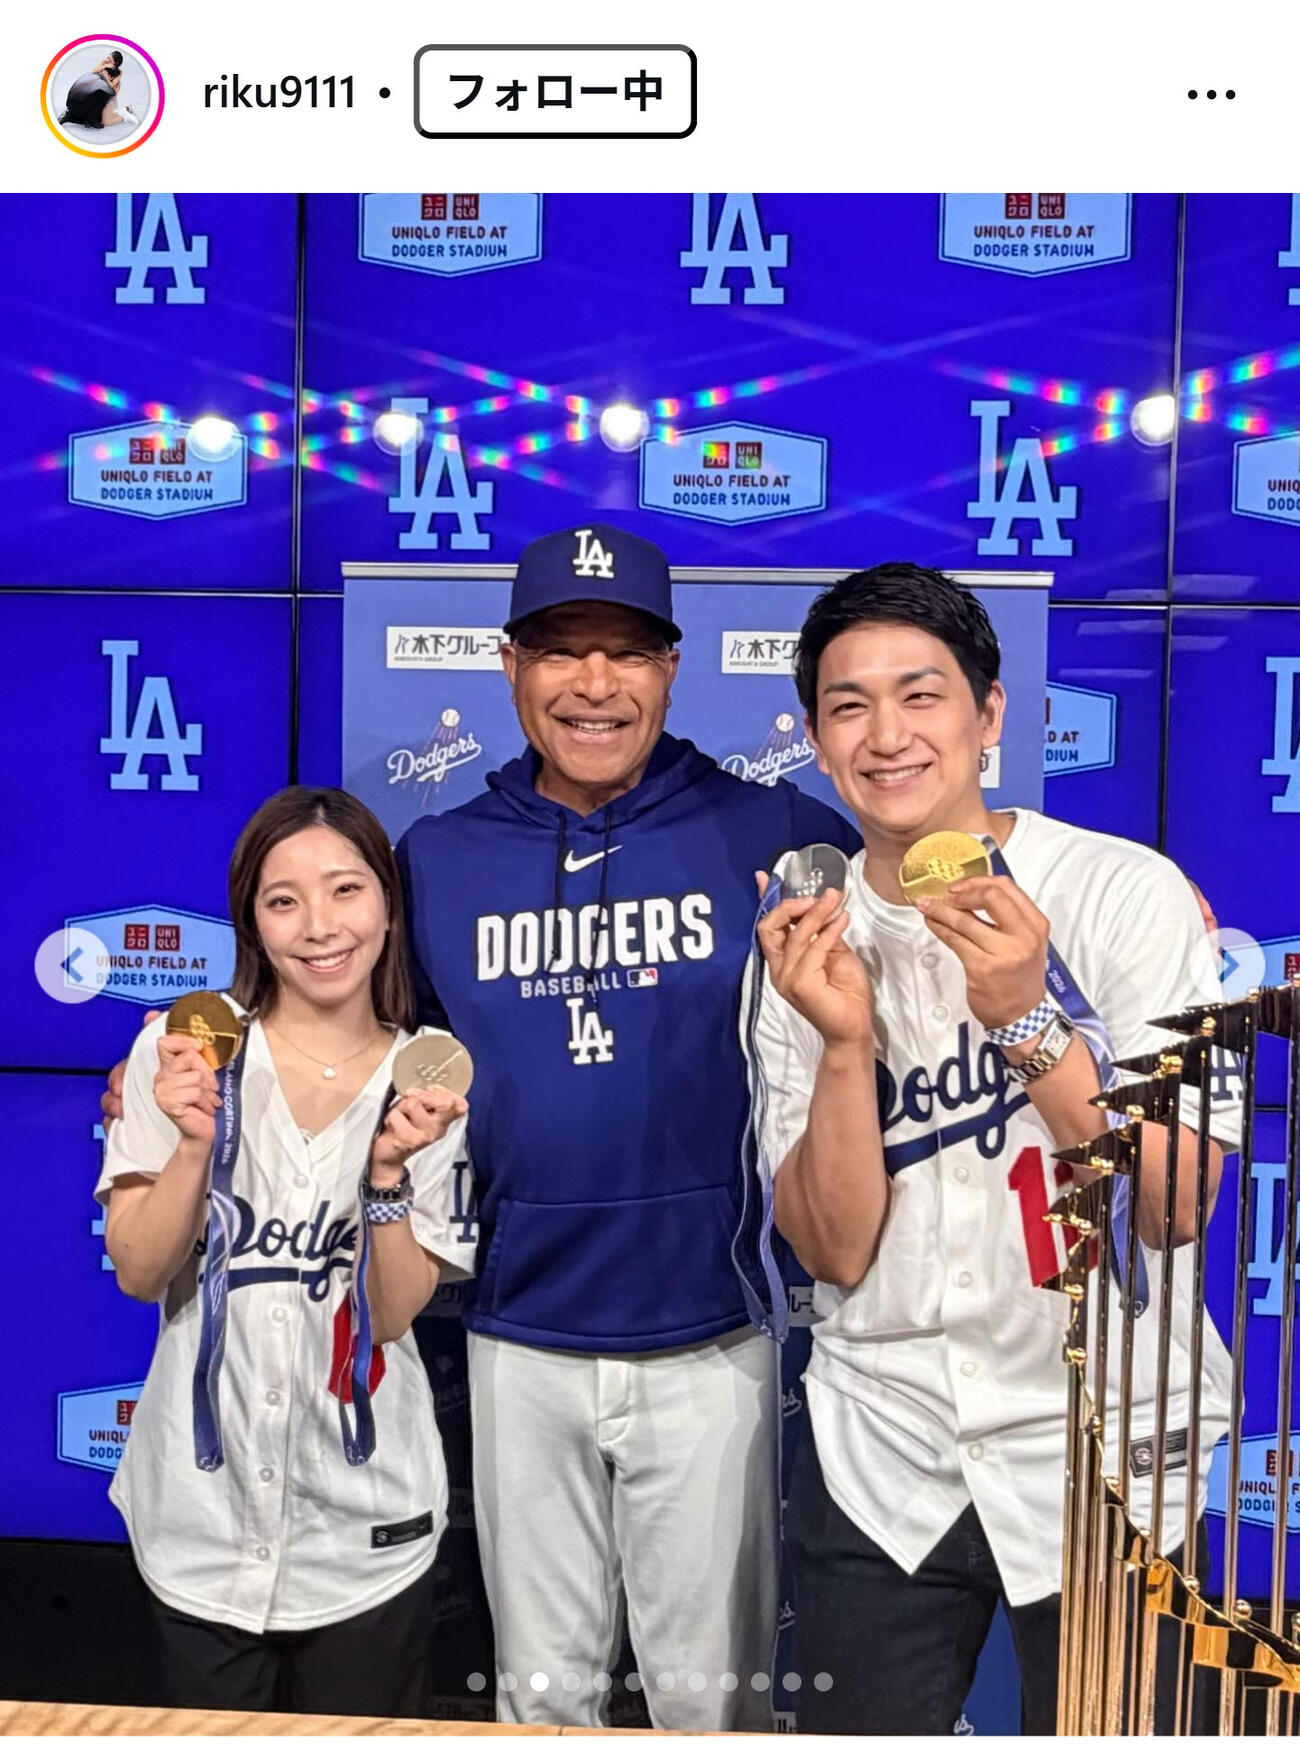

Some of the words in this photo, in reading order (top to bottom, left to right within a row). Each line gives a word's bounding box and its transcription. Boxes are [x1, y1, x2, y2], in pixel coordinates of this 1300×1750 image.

[455, 207, 477, 218] QLO
[1040, 206, 1063, 217] QLO
[391, 226, 441, 241] UNIQLO
[446, 226, 486, 239] FIELD
[490, 226, 508, 239] AT
[973, 225, 1025, 240] UNIQLO
[1030, 225, 1072, 238] FIELD
[1076, 225, 1095, 238] AT
[105, 193, 208, 304] LA
[391, 244, 445, 258] DODGER
[449, 244, 508, 257] STADIUM
[680, 193, 788, 305] LA
[973, 243, 1029, 257] DODGER
[1033, 243, 1095, 257] STADIUM
[100, 470, 149, 485] UNIQLO
[153, 470, 192, 483] FIELD
[196, 470, 213, 483] AT
[388, 397, 493, 550] LA
[966, 400, 1077, 556] LA
[673, 474, 723, 489] UNIQLO
[728, 475, 769, 488] FIELD
[773, 475, 791, 488] AT
[1267, 479, 1300, 494] UNIQ
[100, 487, 152, 501] DODGER
[156, 487, 213, 501] STADIUM
[673, 492, 727, 506] DODGER
[731, 492, 791, 506] STADIUM
[573, 529, 614, 579] LA
[100, 640, 202, 791] LA
[1061, 731, 1079, 744] AT
[387, 732, 482, 785] Dodgers
[720, 737, 817, 788] Dodgers
[1045, 748, 1080, 763] DIUM
[157, 927, 177, 938] UNI
[477, 893, 714, 982] DODGERS
[157, 938, 178, 949] QLO
[96, 955, 143, 969] UNIQLO
[148, 956, 187, 969] FIELD
[190, 957, 208, 970] AT
[96, 972, 147, 986] DODGER
[150, 974, 208, 988] STADIUM
[566, 997, 614, 1066] LA
[88, 1429, 129, 1444] UNIQL
[88, 1446, 124, 1459] DODG
